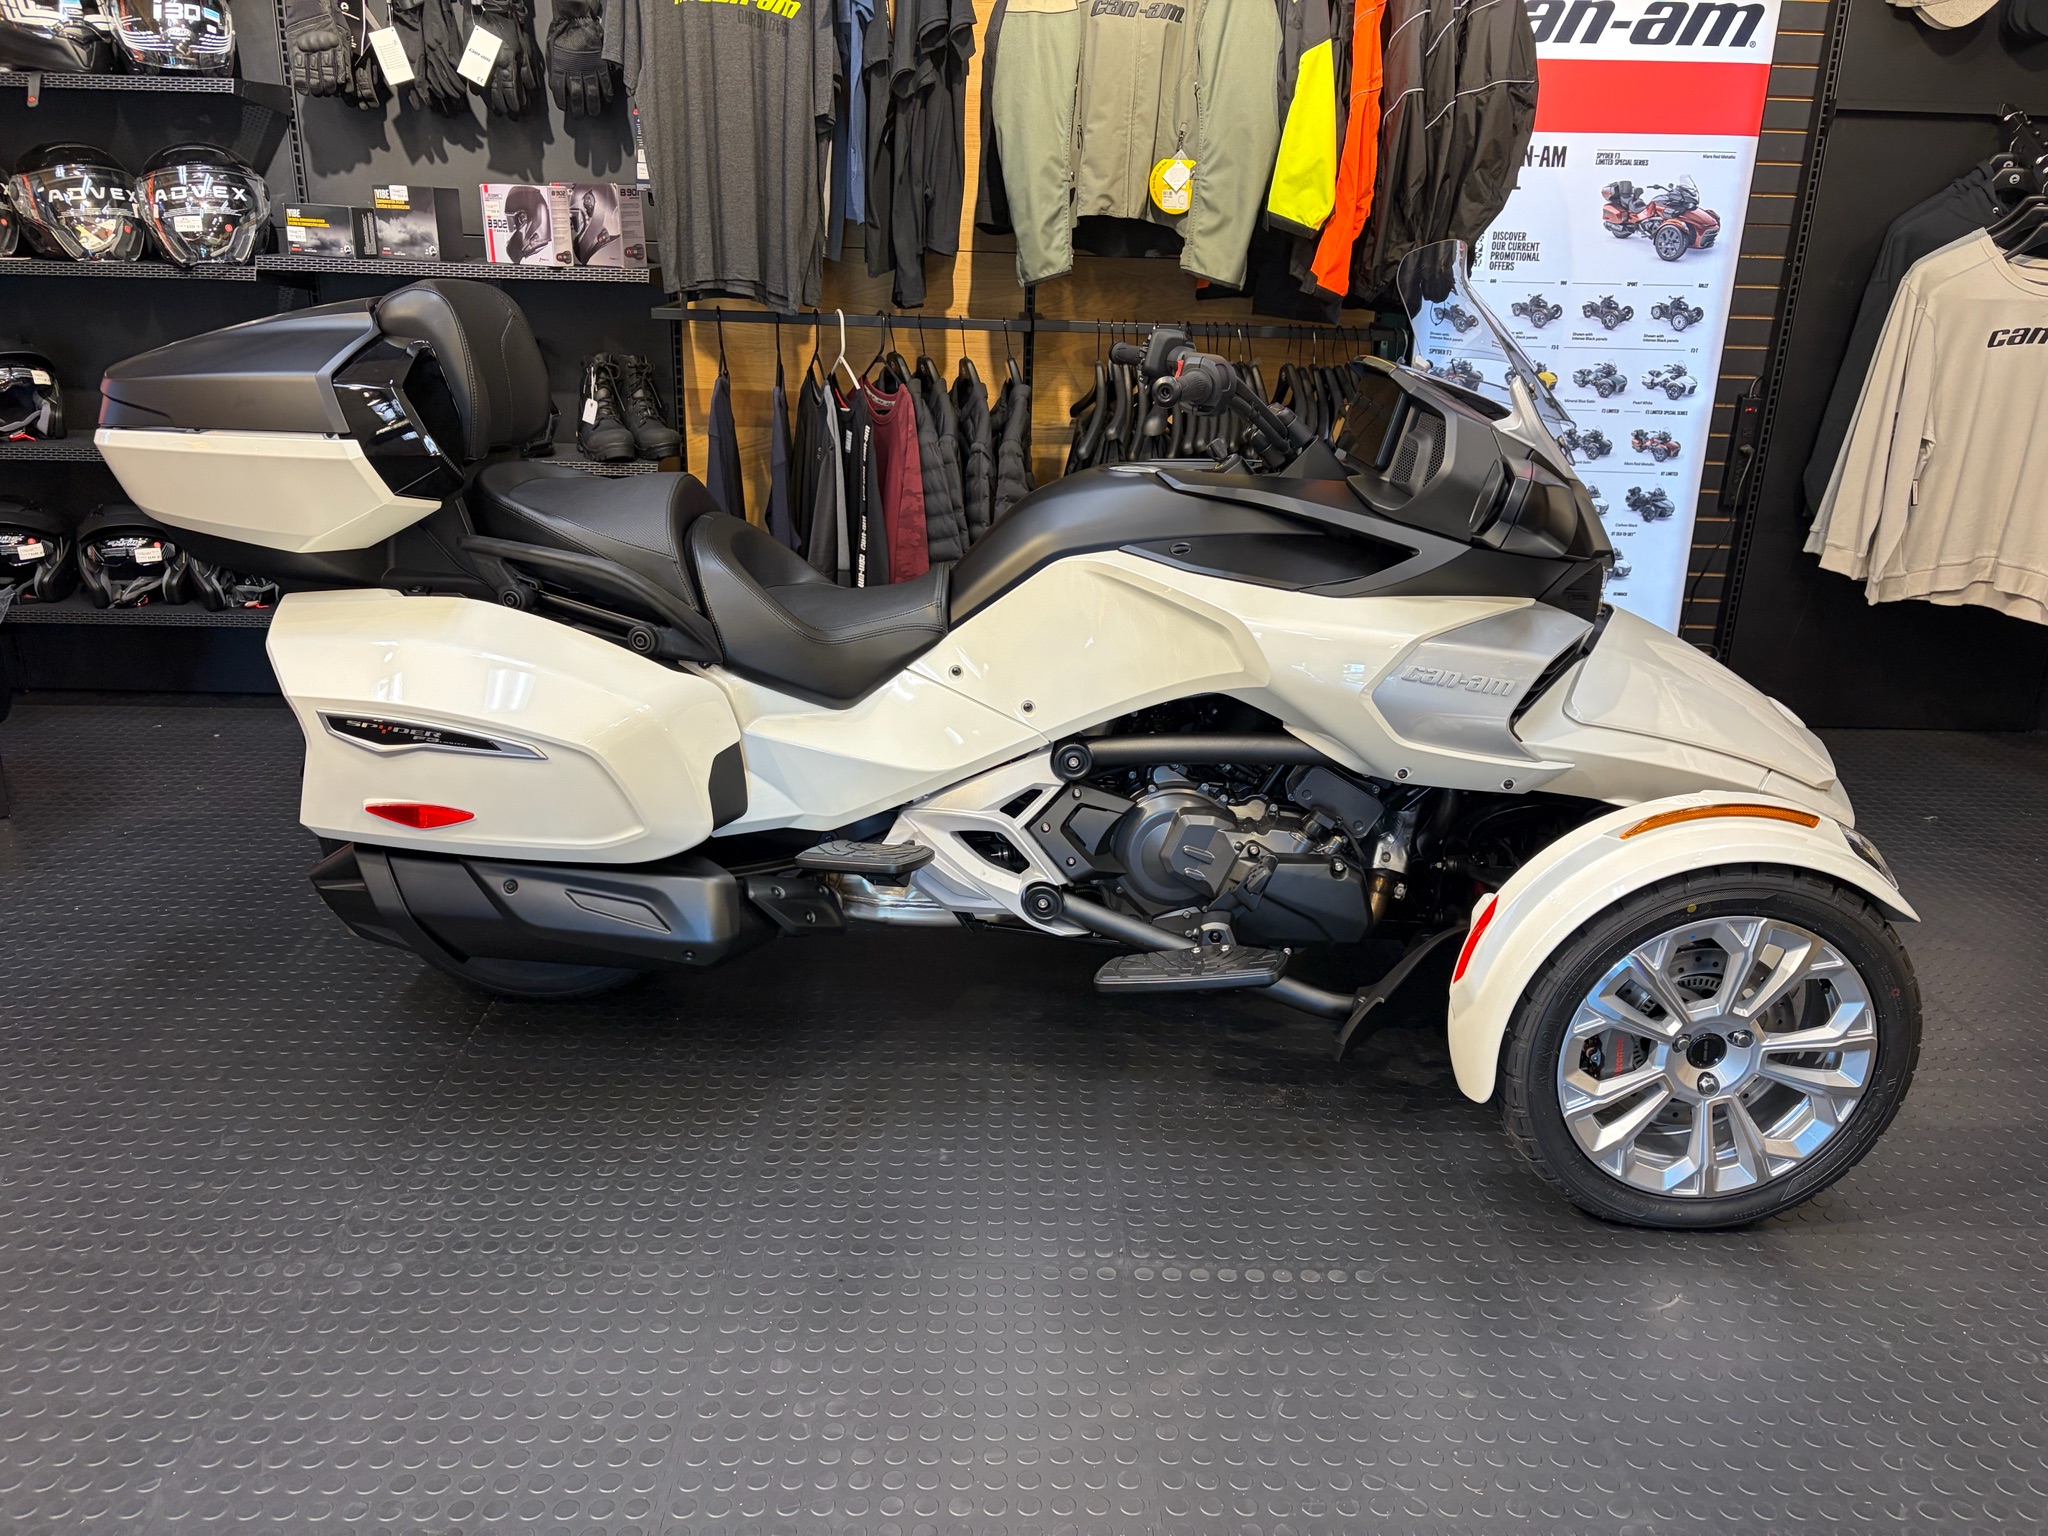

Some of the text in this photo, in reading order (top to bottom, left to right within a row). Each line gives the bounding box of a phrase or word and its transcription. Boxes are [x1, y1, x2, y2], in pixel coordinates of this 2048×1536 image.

[1091, 0, 1184, 22] can-am
[1527, 0, 1757, 47] an-am
[1523, 145, 1567, 168] N-AM
[49, 187, 136, 203] ADVEX
[154, 186, 248, 202] ADVEX
[374, 188, 390, 200] VIBE
[286, 208, 301, 218] VIBE
[1492, 231, 1527, 241] DISCOVER
[1491, 242, 1540, 252] OUR CURRENT
[1490, 251, 1540, 262] PROMOTIONAL
[1489, 261, 1515, 271] OFFERS
[1401, 665, 1516, 697] can-am
[346, 720, 442, 738] SPYDER
[412, 735, 440, 743] F3
